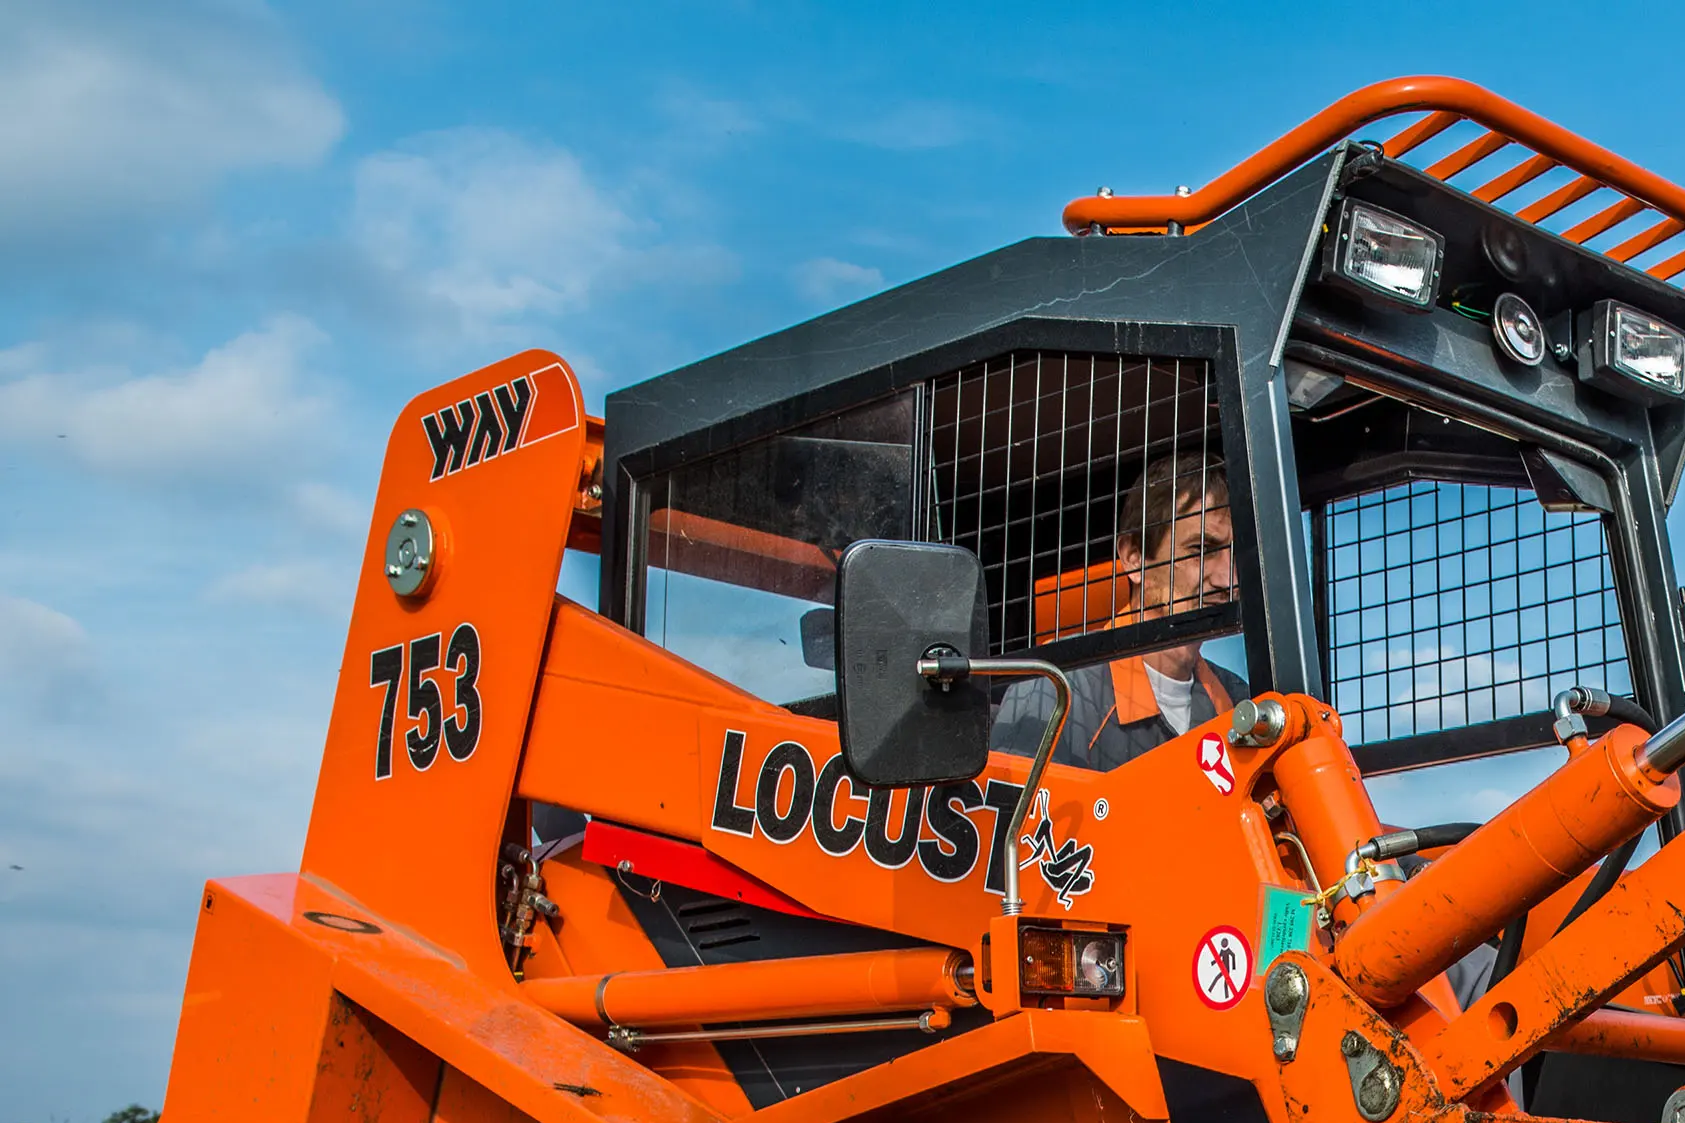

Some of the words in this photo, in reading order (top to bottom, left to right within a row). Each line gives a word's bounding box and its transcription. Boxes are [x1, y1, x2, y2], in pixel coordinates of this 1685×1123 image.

[421, 375, 533, 482] WAY
[369, 622, 482, 781] 753
[711, 729, 1040, 895] LOCUST
